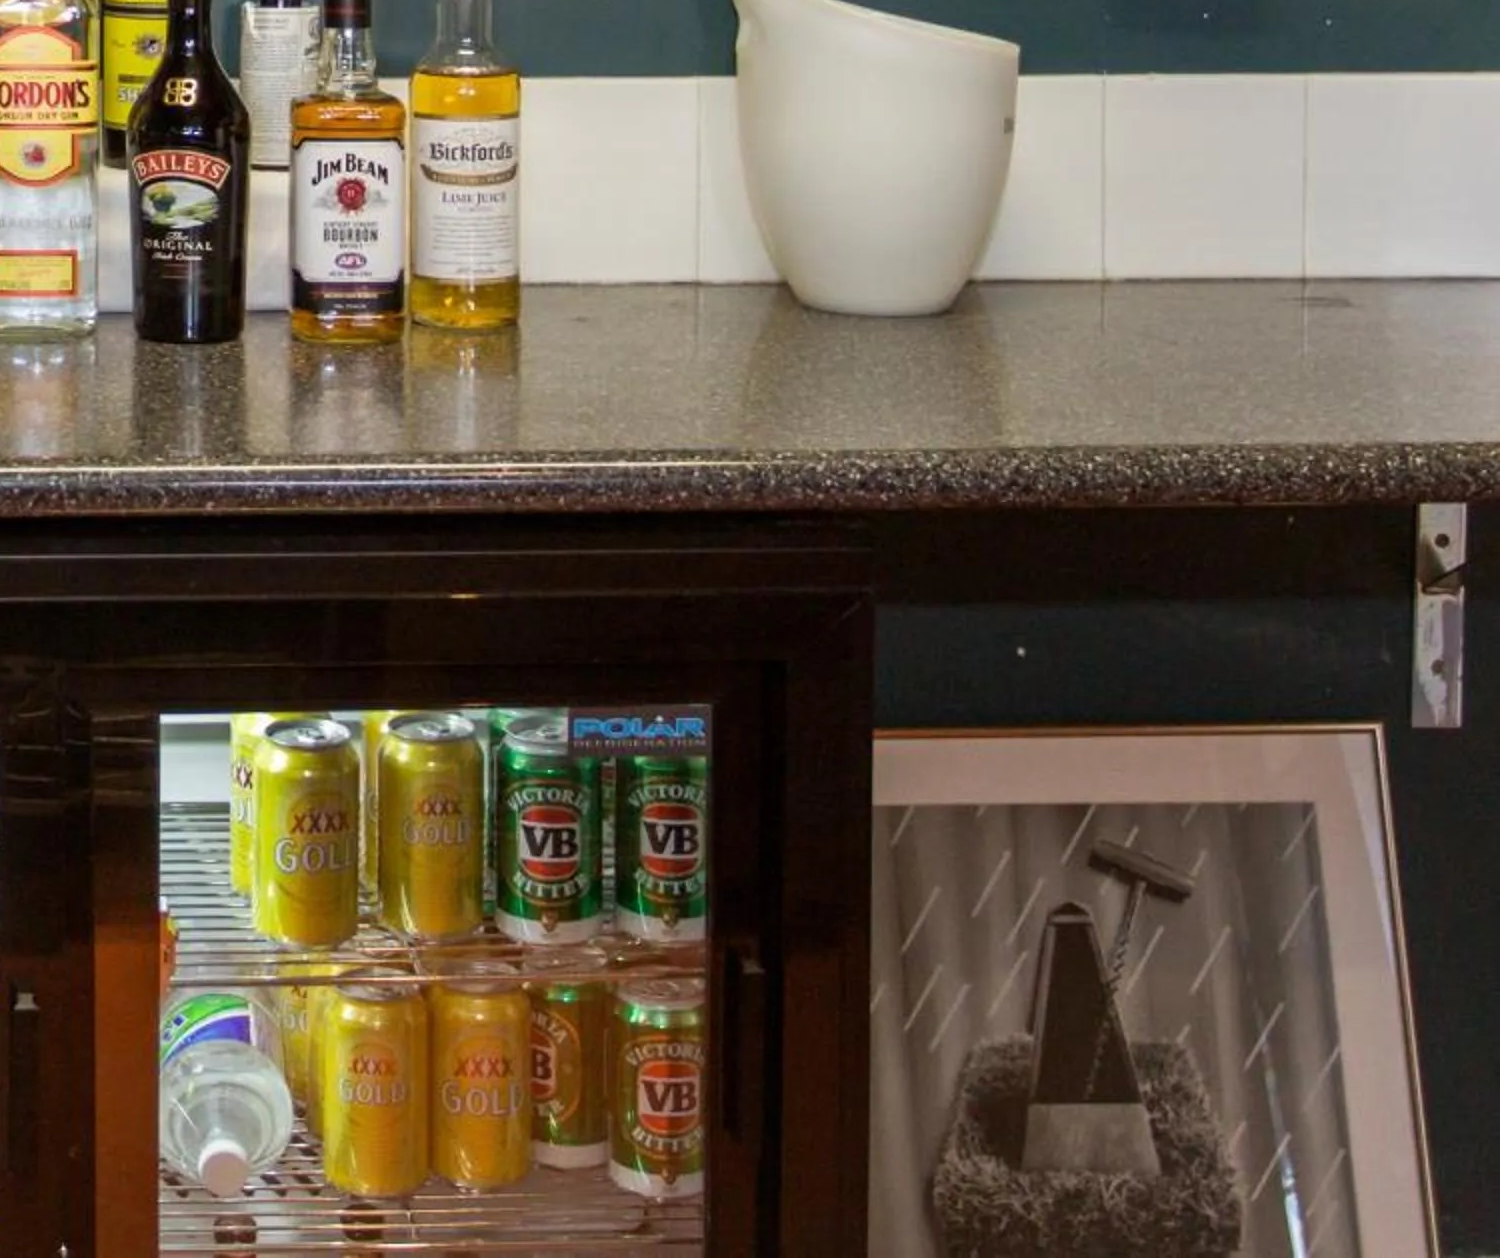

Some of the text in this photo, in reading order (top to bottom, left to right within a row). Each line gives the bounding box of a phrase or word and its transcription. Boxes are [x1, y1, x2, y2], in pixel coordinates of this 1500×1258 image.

[136, 155, 224, 179] BAILEYS
[311, 153, 389, 186] JIM BEAM
[143, 241, 213, 252] ORIGINAL
[323, 228, 378, 242] BOURBON
[573, 716, 706, 739] POLAR
[628, 783, 706, 807] VICTORI
[291, 811, 349, 834] XXXX
[403, 819, 473, 844] GOLD
[522, 824, 578, 858] VB
[643, 820, 699, 856] VB
[339, 1078, 406, 1105] GOLD
[441, 1078, 525, 1116] GOLD
[640, 1079, 698, 1113] VB
